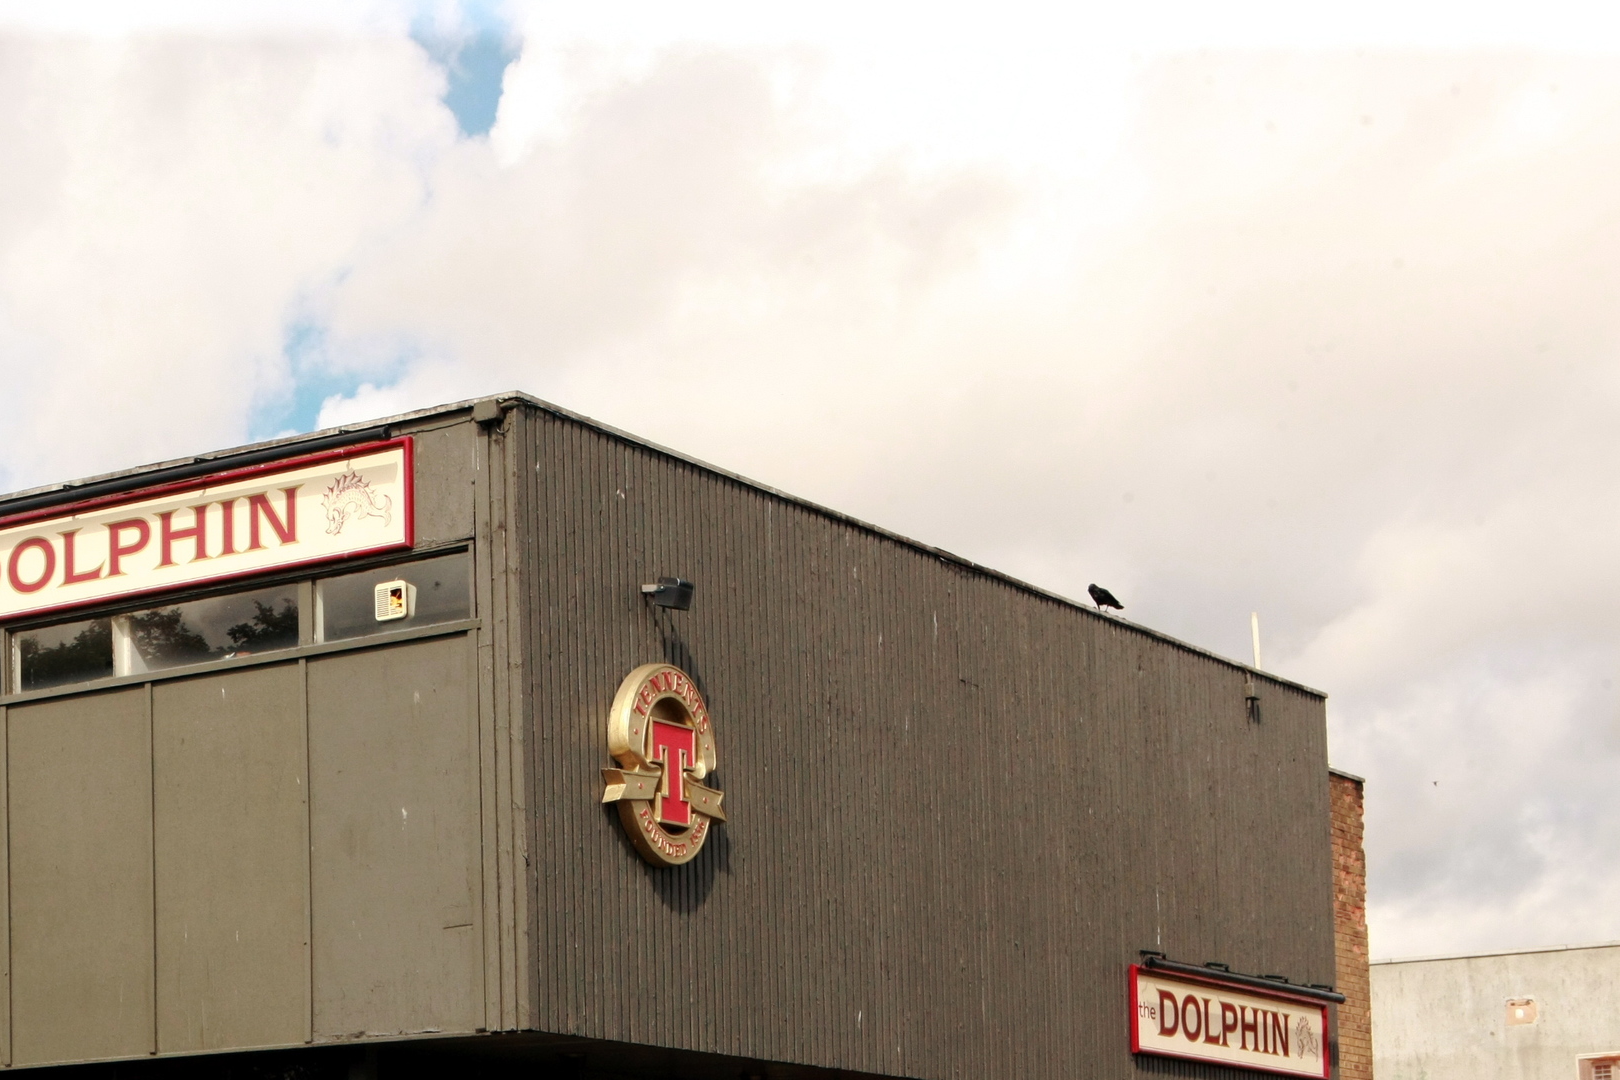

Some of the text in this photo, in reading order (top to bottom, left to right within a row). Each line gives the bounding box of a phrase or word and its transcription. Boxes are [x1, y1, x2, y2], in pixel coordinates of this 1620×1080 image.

[650, 717, 696, 828] T
[640, 808, 687, 858] FOUNDED
[1138, 988, 1290, 1058] the DOLPHIN
